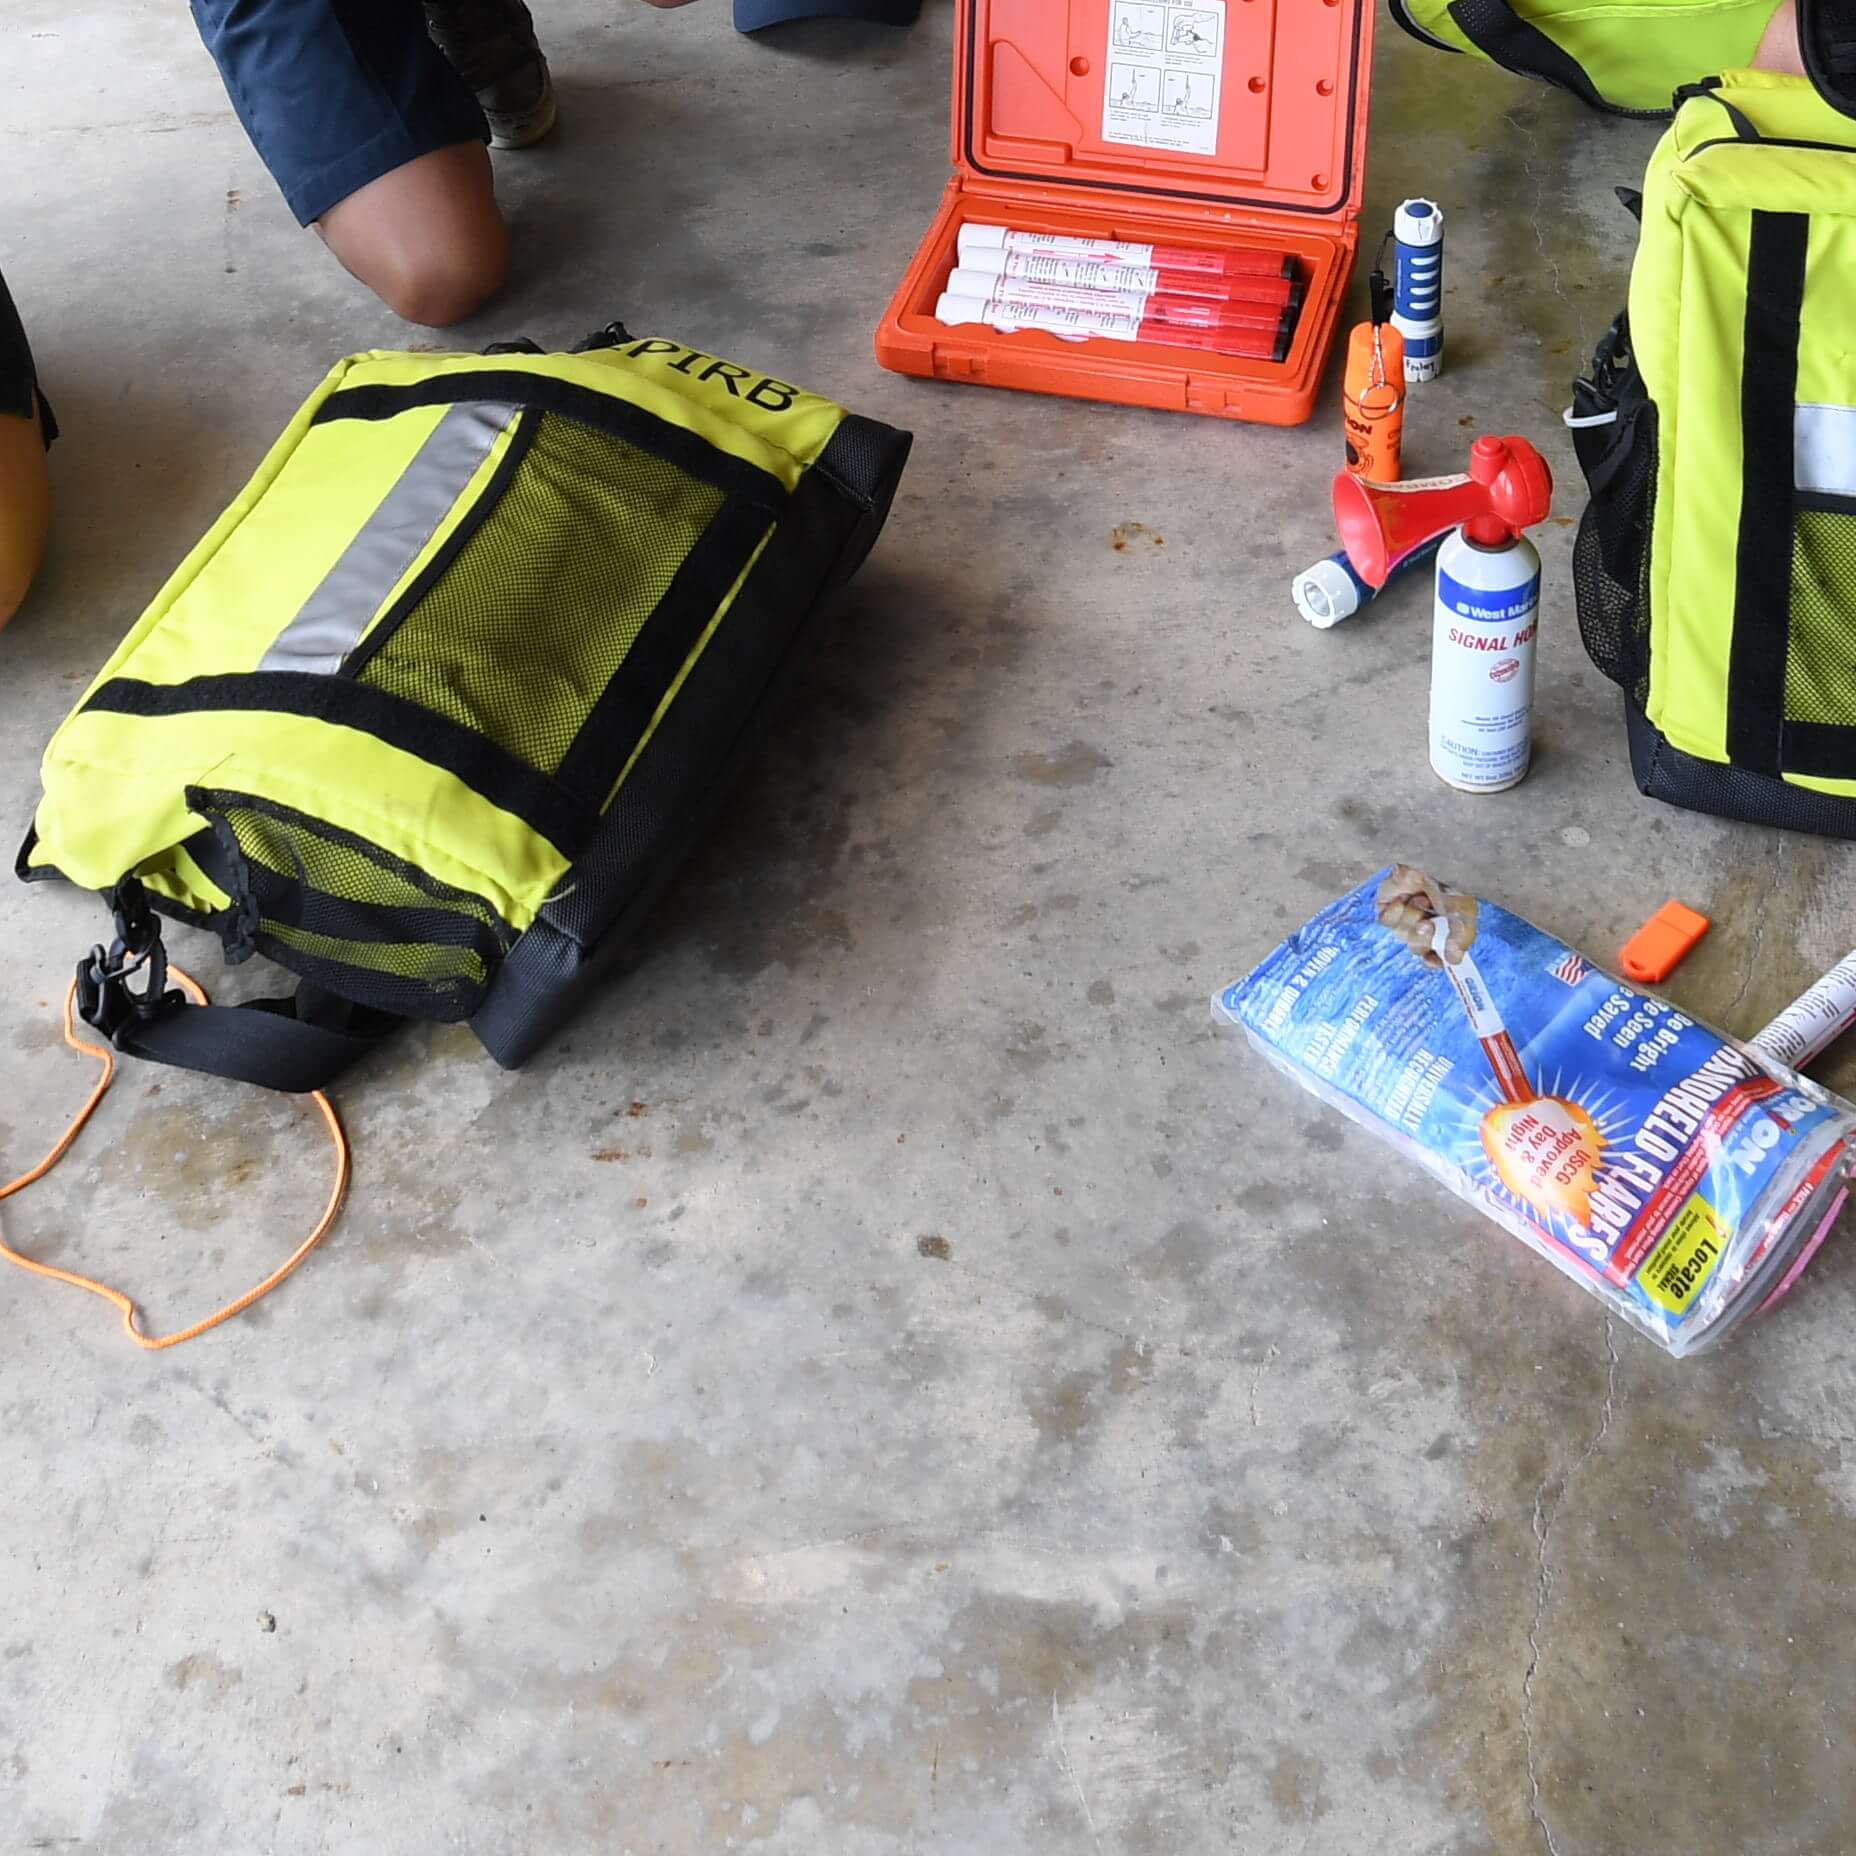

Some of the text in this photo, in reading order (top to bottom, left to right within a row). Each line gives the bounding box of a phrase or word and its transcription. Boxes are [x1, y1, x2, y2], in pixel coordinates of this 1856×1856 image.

[611, 339, 801, 412] PIRB
[1448, 621, 1538, 652] SIGNAL HO
[1471, 606, 1505, 620] West
[1581, 993, 1630, 1040] Saved
[1612, 1009, 1656, 1050] Seen
[1628, 1025, 1682, 1074] Bright
[1400, 1055, 1456, 1133] UNIVERSALLY
[1525, 1124, 1558, 1153] Day
[1528, 1125, 1583, 1191] Approved
[1564, 1041, 1760, 1263] HANDHELD FLARES
[1553, 1147, 1593, 1188] USCG
[1668, 1237, 1719, 1302] Locate
